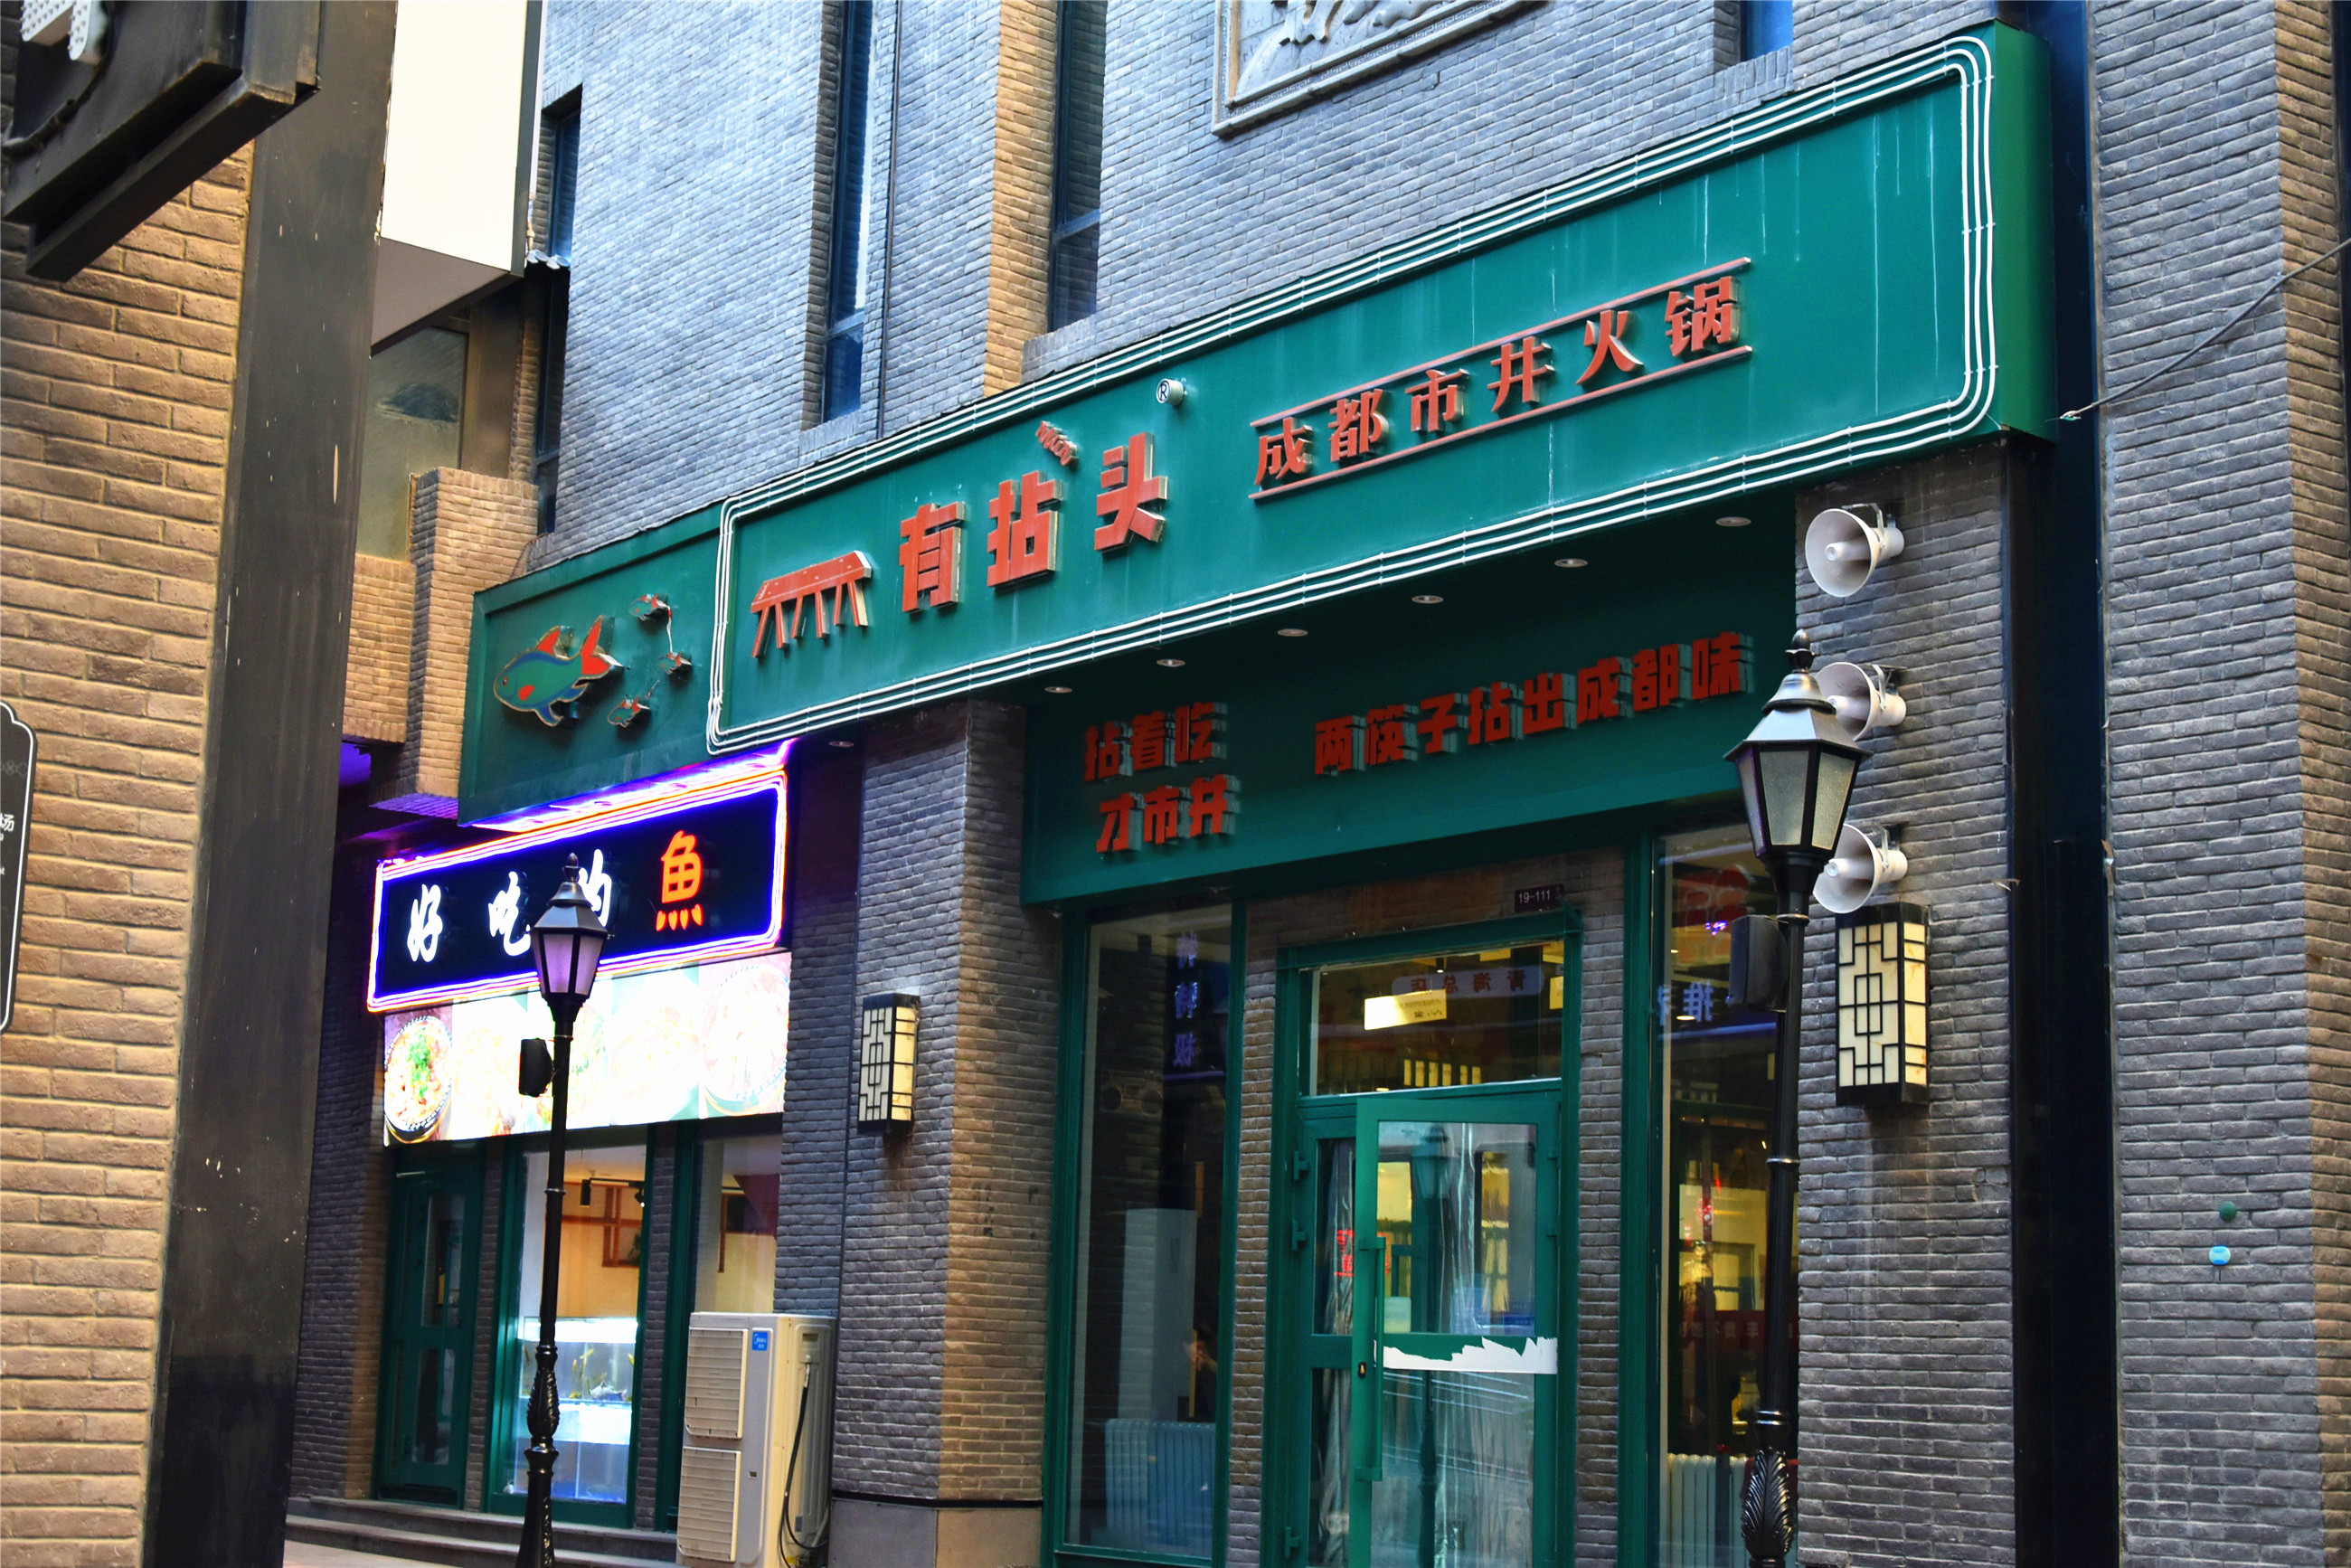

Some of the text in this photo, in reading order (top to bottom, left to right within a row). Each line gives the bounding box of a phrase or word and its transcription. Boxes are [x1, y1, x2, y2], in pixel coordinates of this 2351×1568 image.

[1253, 276, 1739, 486] 成都市井火锅
[900, 432, 1165, 612] 有拈头
[1083, 702, 1221, 782] 拈着吃
[1315, 631, 1742, 775] 两筷子拈出成都味
[1095, 773, 1232, 853] 才市井
[1519, 889, 1550, 903] 19-111
